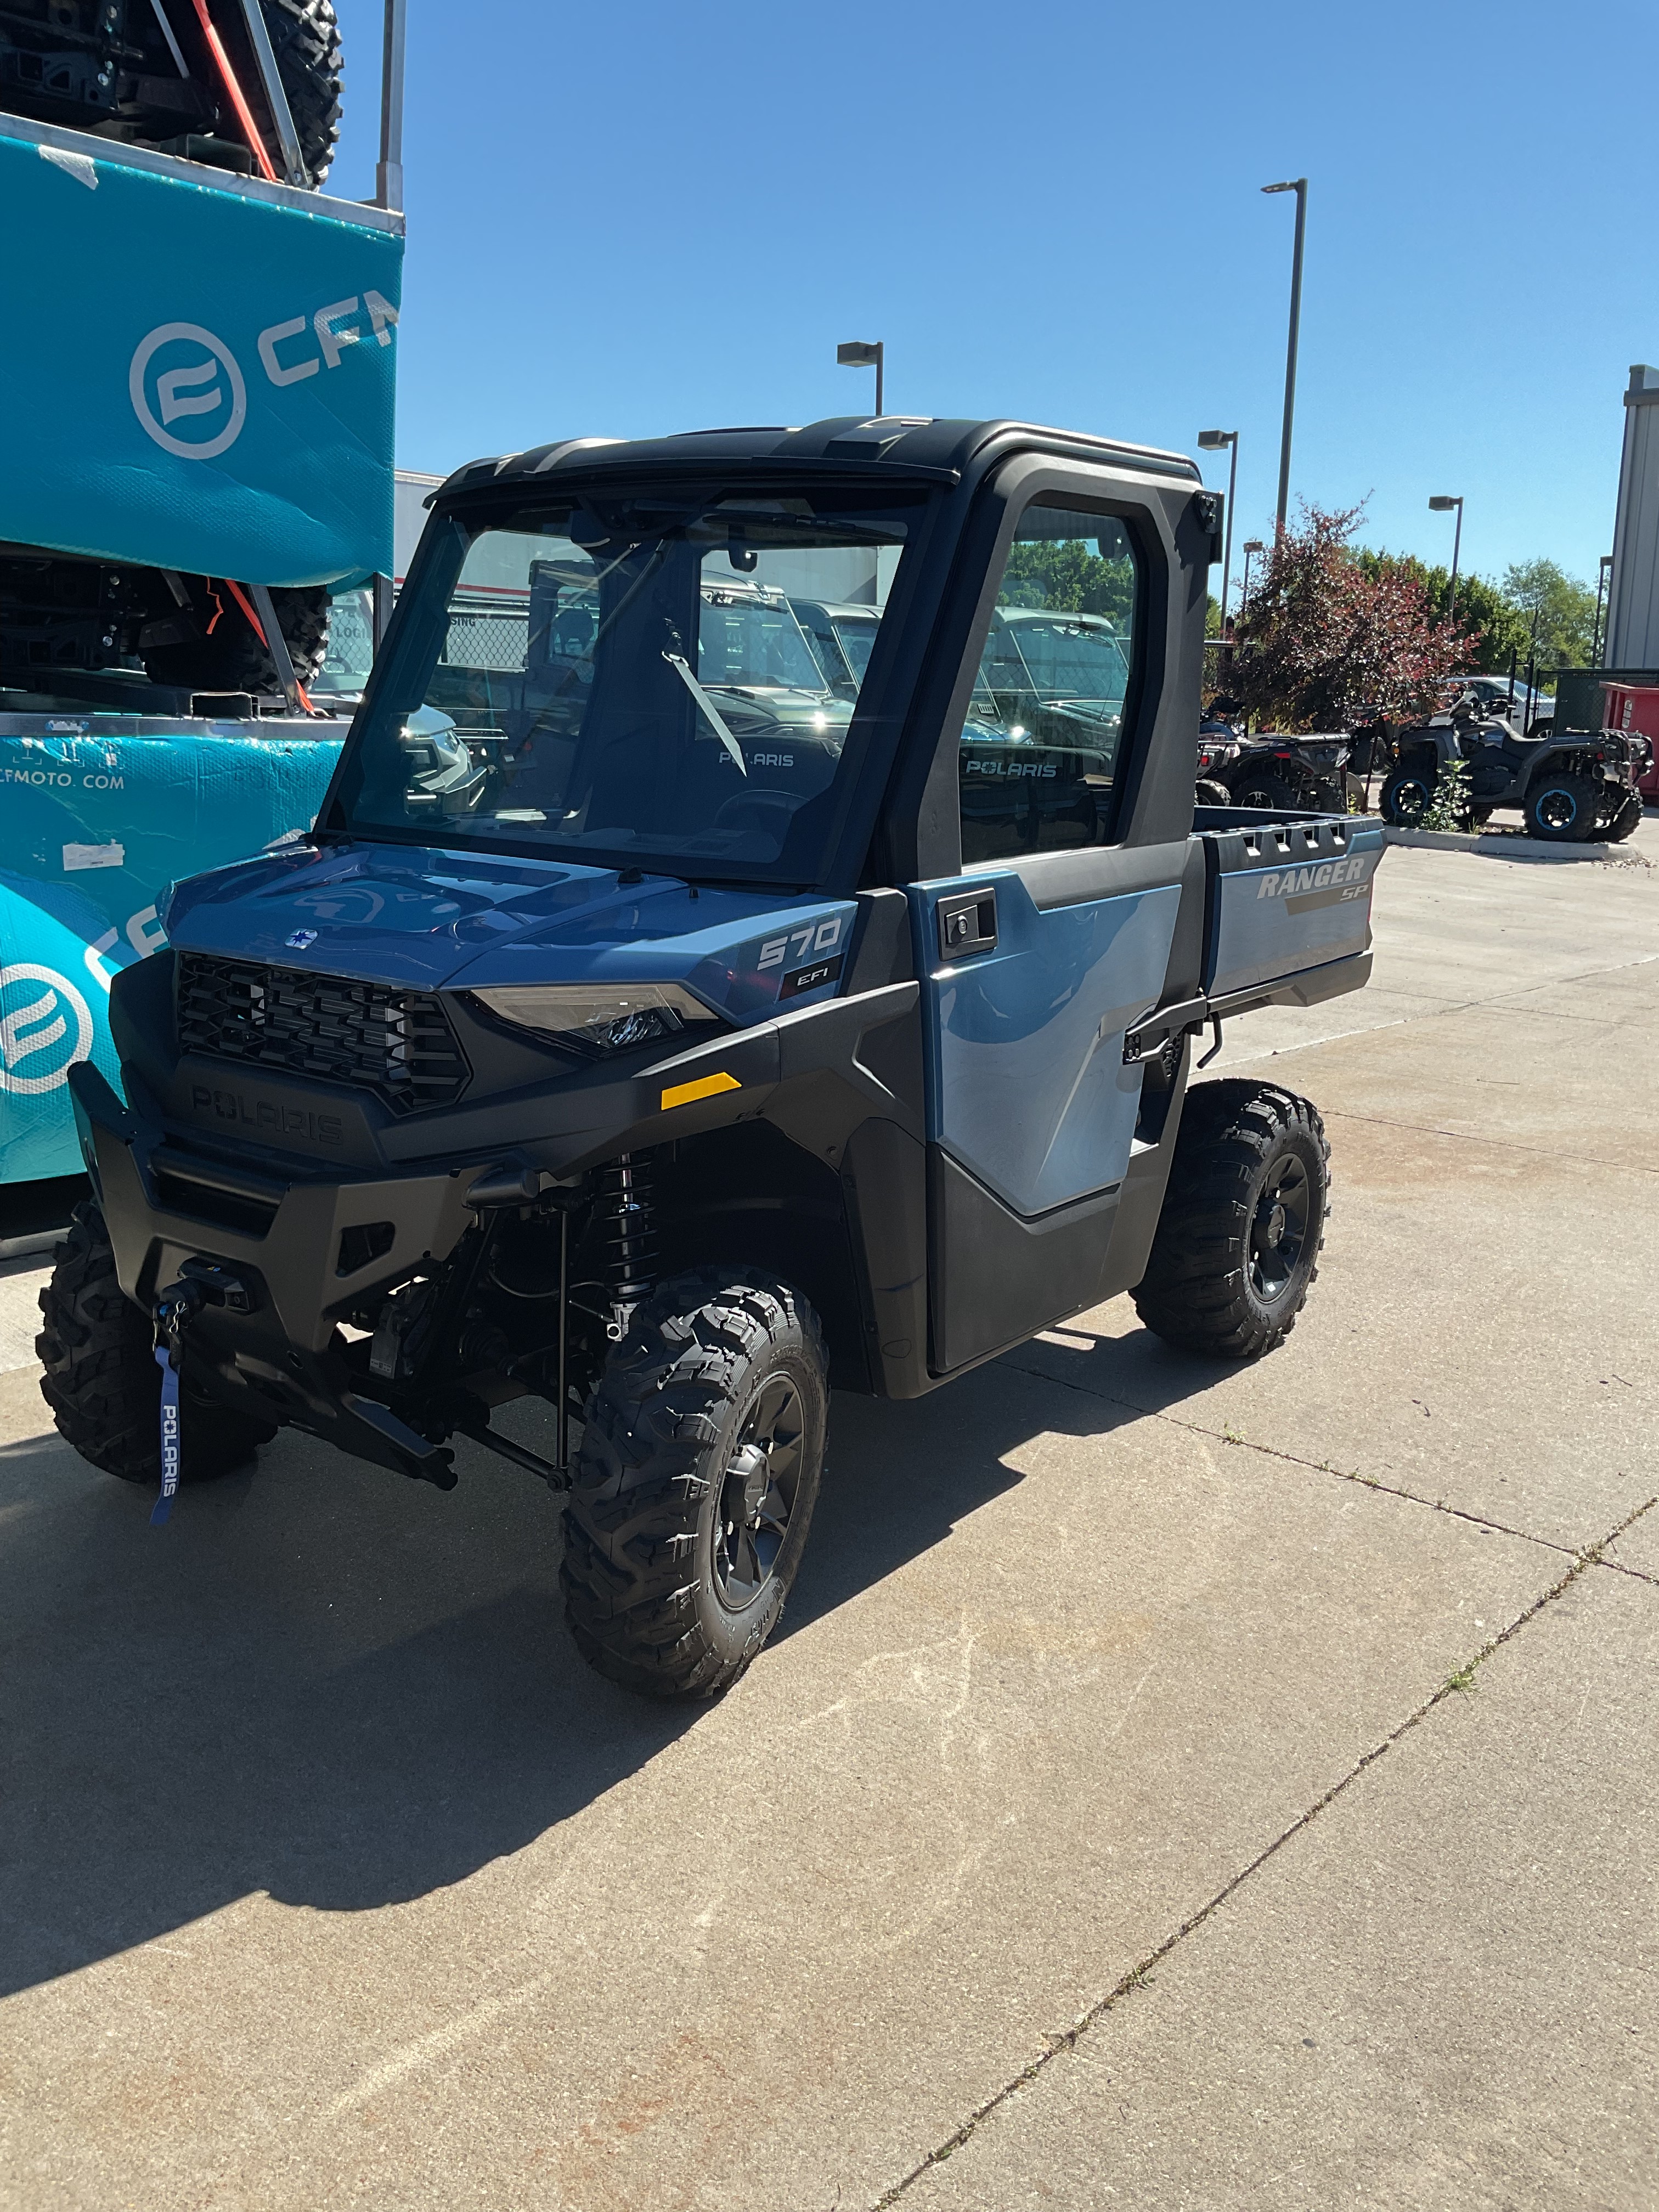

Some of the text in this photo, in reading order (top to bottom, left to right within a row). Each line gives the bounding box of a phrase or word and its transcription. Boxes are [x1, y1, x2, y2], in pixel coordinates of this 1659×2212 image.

[719, 752, 794, 767] PARIS
[966, 760, 1057, 777] POLARIS
[1256, 858, 1364, 900] RANGER
[1340, 884, 1369, 901] SP
[757, 918, 842, 970] 570
[797, 968, 828, 986] EFI
[193, 1085, 342, 1146] POLARIS
[163, 1405, 178, 1497] POLARIS
